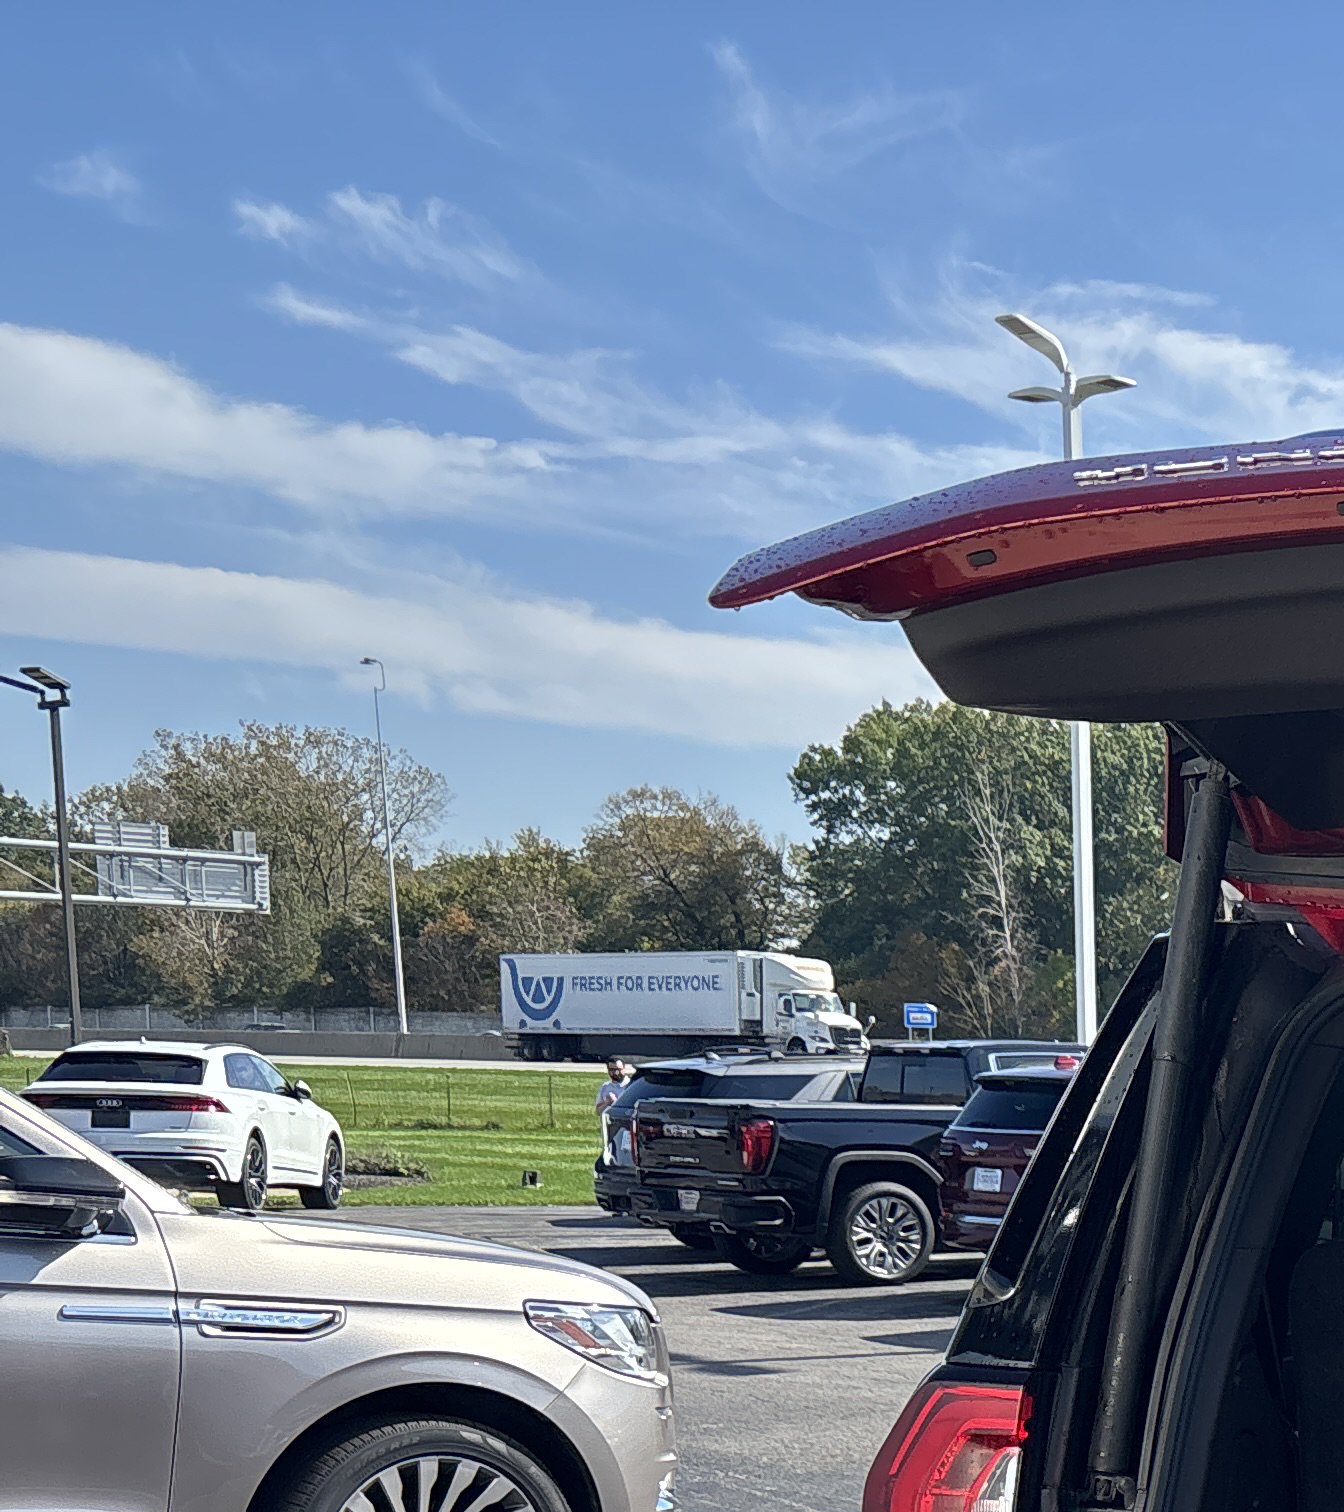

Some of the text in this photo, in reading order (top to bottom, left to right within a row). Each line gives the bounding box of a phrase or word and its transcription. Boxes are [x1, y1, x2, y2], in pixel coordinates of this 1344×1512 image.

[571, 974, 720, 992] FRESH FOR EVERYONE
